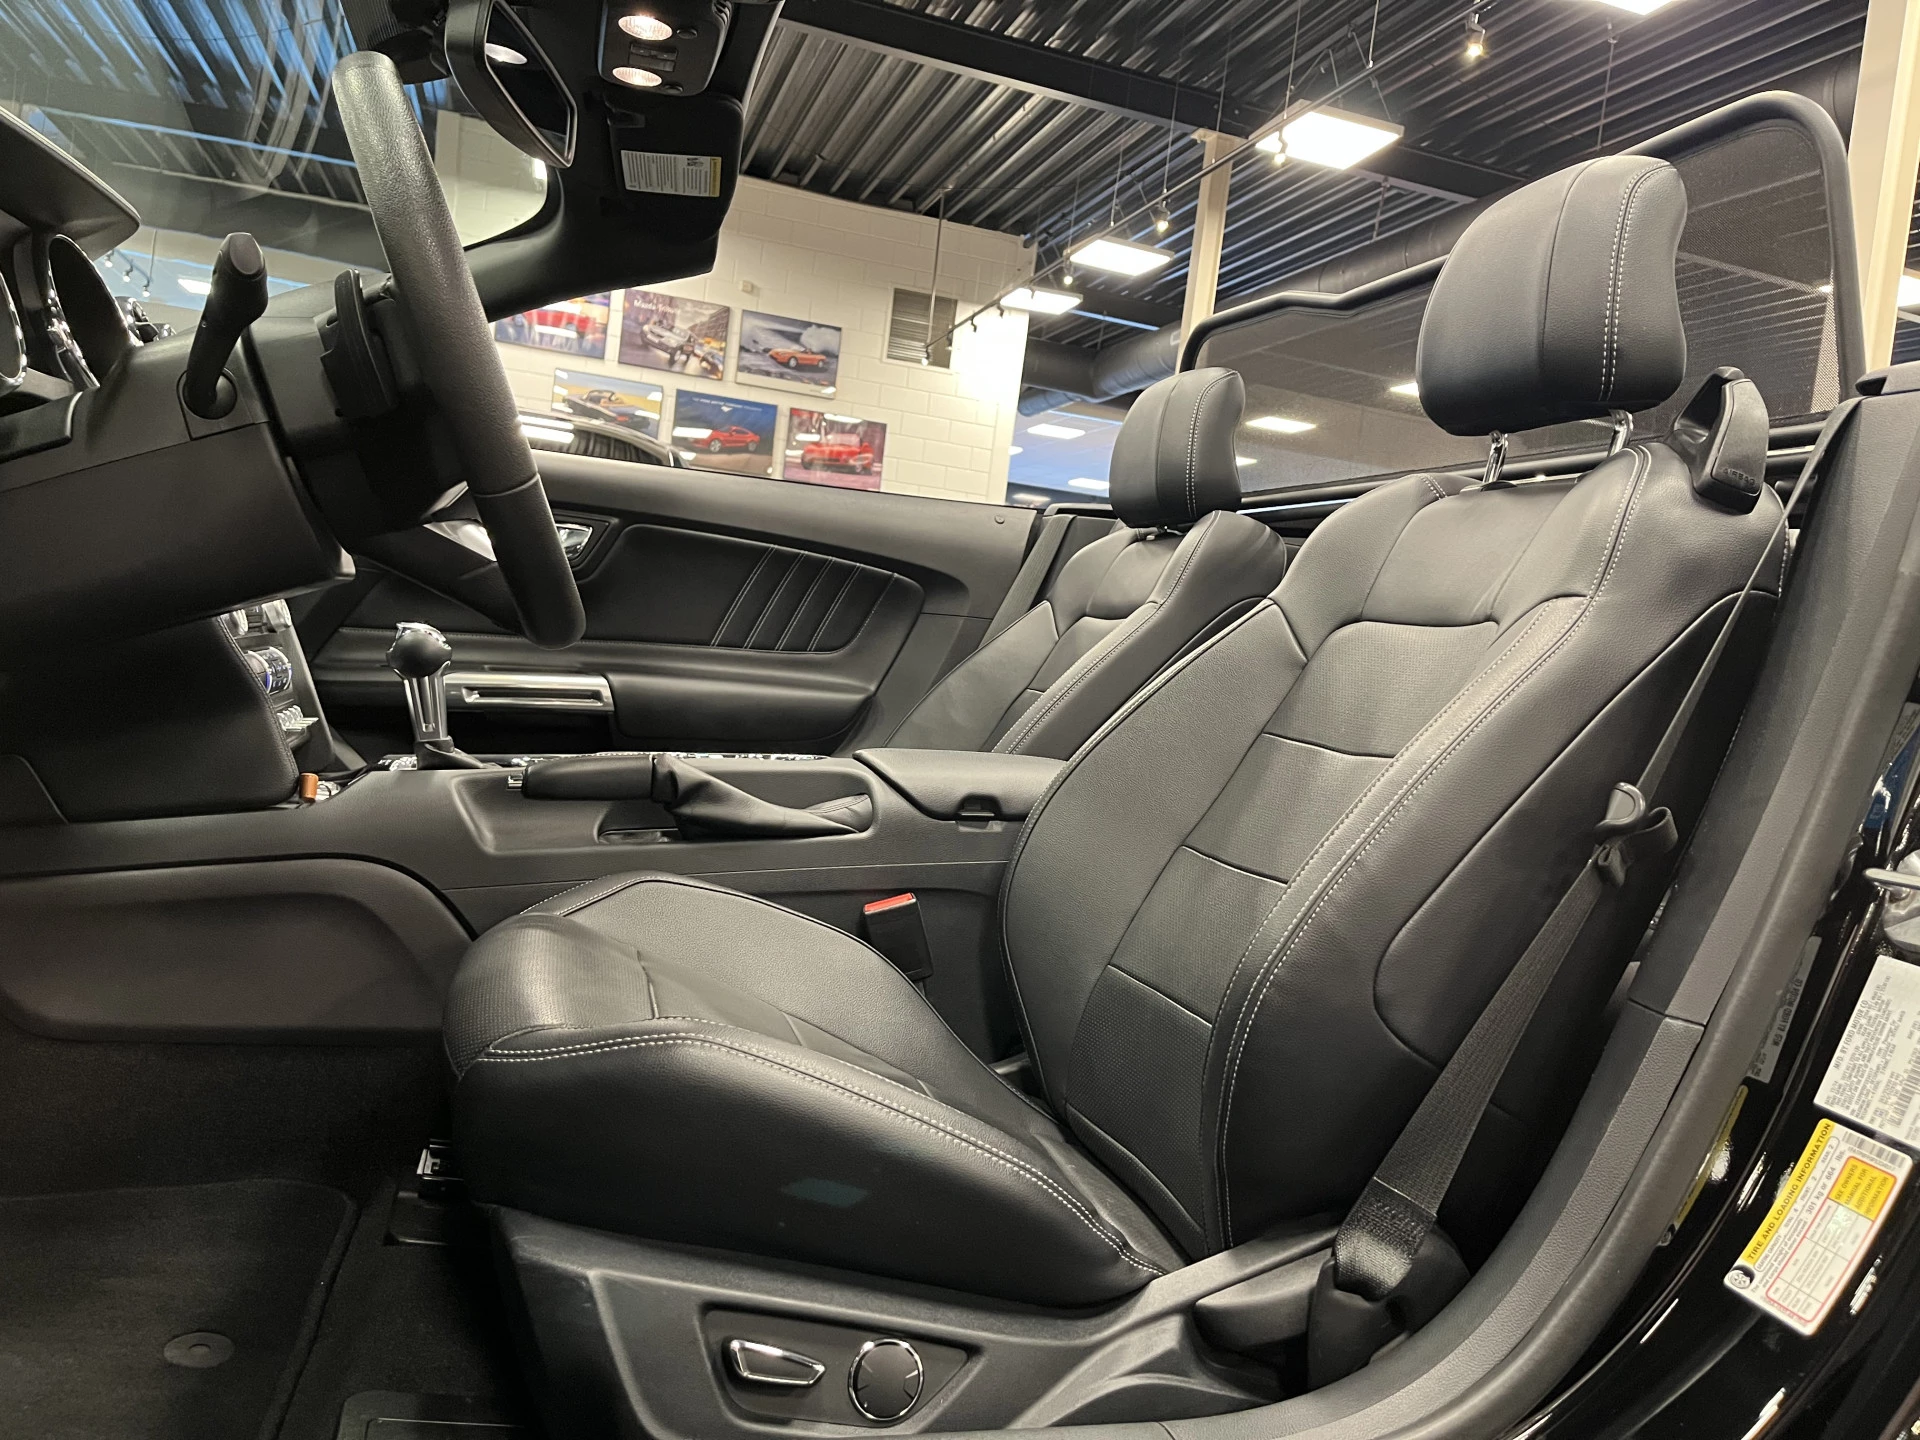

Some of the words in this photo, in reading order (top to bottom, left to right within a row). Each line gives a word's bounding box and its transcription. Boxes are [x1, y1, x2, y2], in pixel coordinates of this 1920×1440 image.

[1722, 467, 1756, 487] AIRBAG
[1849, 1008, 1864, 1029] MOTOR
[1842, 1028, 1855, 1045] FORD
[1838, 1044, 1848, 1054] BY
[1746, 1239, 1764, 1261] TIRE
[1760, 1220, 1776, 1240] AND
[1772, 1182, 1799, 1221] LOADING
[1795, 1122, 1831, 1182] INFORMATION
[1805, 1200, 1816, 1214] 301
[1814, 1190, 1824, 1200] kg
[1820, 1181, 1828, 1190] or
[1824, 1166, 1835, 1180] 664
